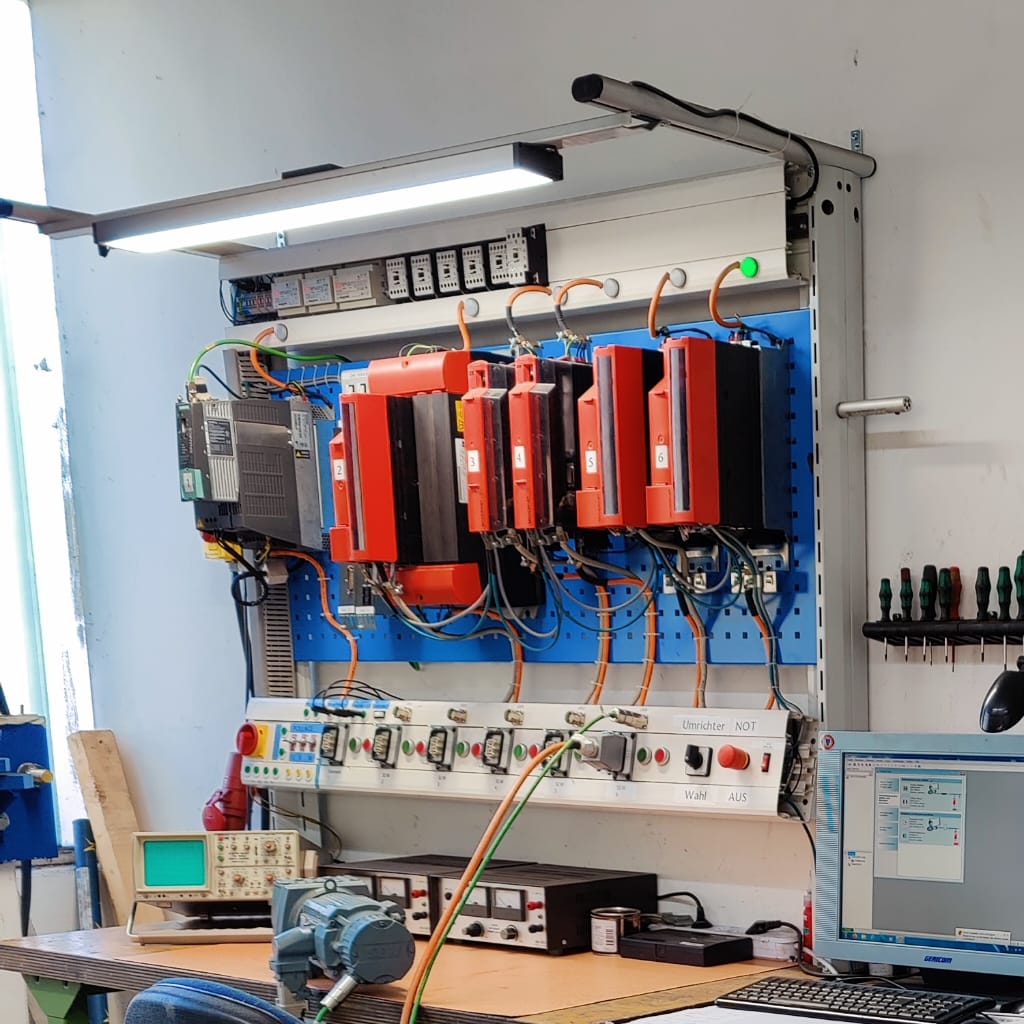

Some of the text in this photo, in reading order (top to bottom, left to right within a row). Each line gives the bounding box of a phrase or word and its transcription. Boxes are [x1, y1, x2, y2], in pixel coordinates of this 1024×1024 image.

[470, 456, 476, 467] 3
[588, 457, 594, 468] 5
[658, 452, 664, 463] 6
[336, 464, 343, 476] 2
[682, 720, 757, 731] Umrichter NOT
[685, 790, 748, 802] Wahl AUS
